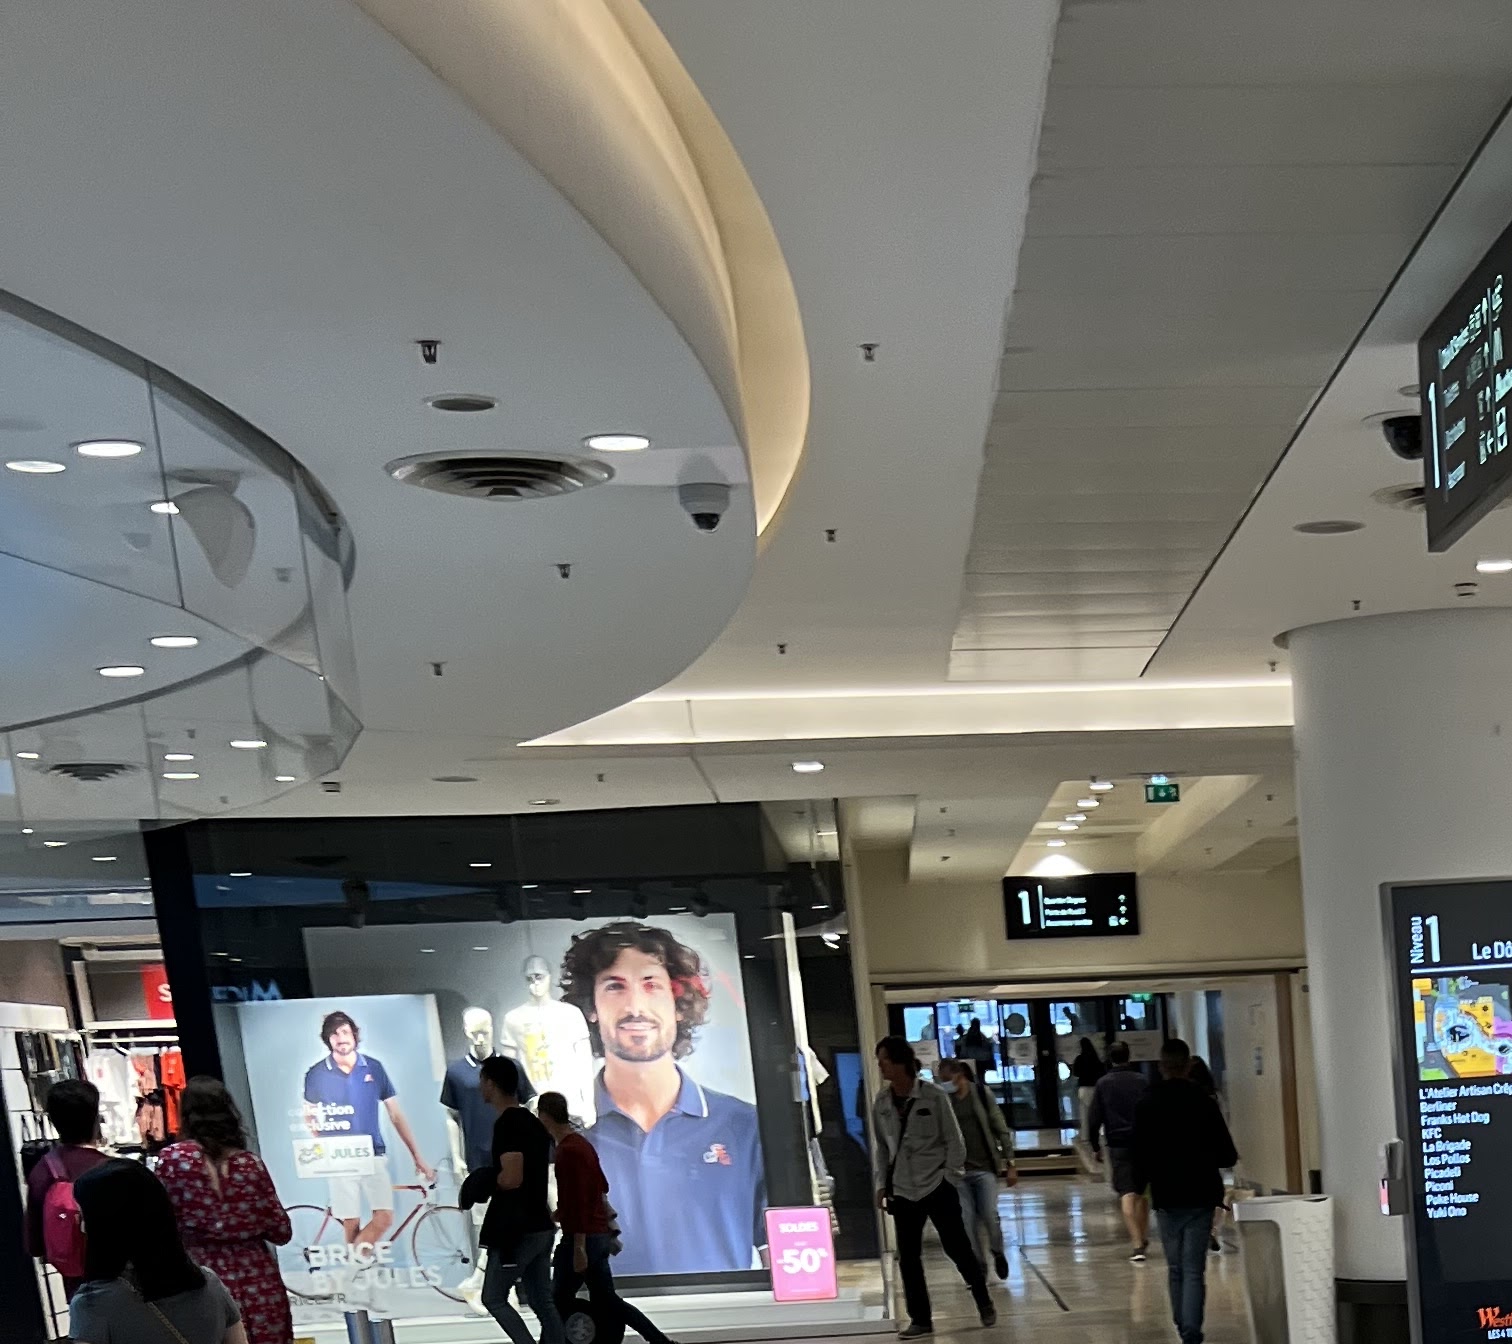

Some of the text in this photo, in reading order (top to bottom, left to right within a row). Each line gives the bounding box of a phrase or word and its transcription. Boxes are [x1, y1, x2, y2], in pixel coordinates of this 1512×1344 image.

[1410, 916, 1424, 964] Niveau
[1426, 915, 1440, 962] 1
[1472, 943, 1491, 960] Le
[288, 1102, 354, 1117] collection
[1422, 1128, 1442, 1139] KFC
[331, 1147, 370, 1159] JULES
[1423, 1142, 1435, 1153] La
[308, 1241, 395, 1267] BRICE
[356, 1265, 442, 1291] JULES
